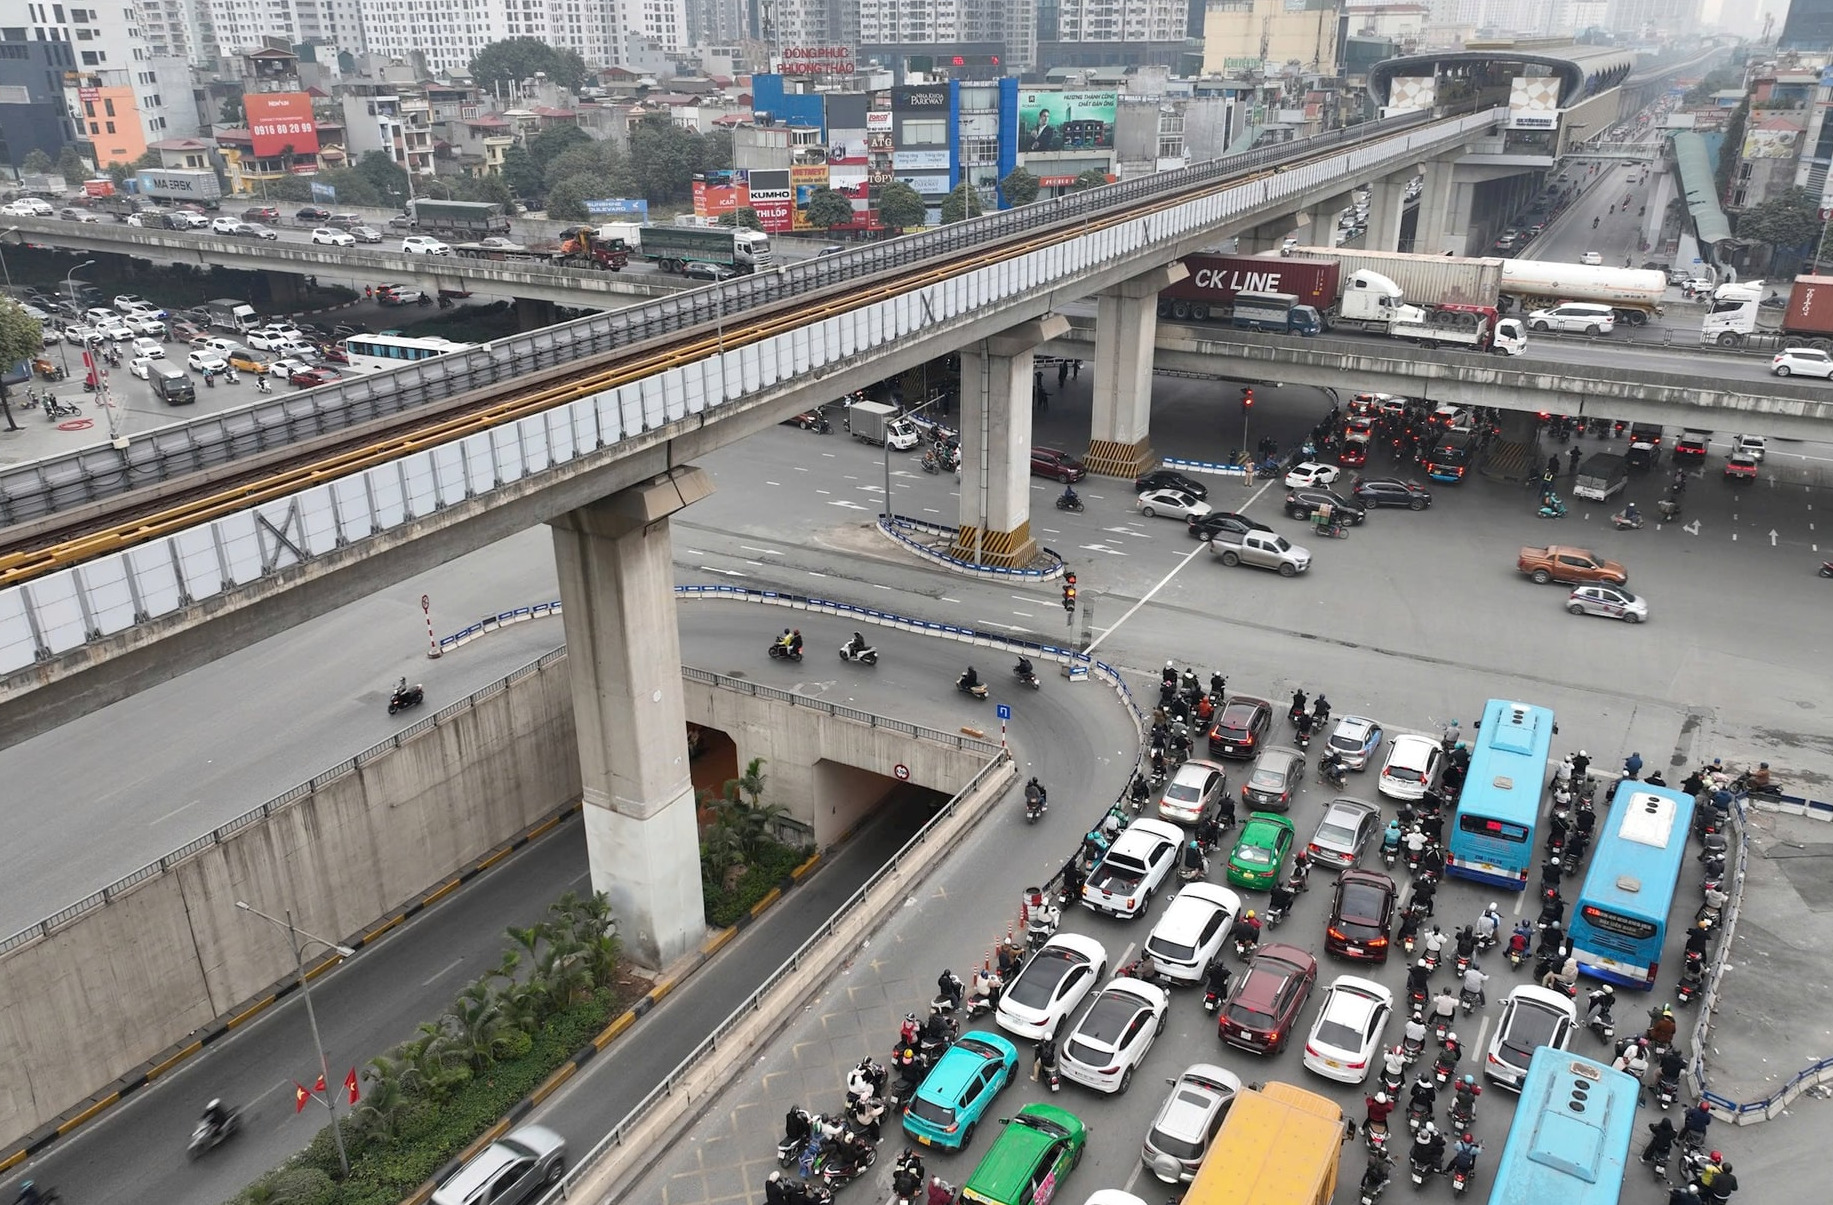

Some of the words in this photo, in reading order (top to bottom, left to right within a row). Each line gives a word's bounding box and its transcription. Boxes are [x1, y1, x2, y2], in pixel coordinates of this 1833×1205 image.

[911, 95, 943, 105] PARKWAY
[254, 124, 275, 135] 0916
[302, 122, 312, 133] 99
[871, 138, 892, 147] ATG
[154, 179, 193, 191] MAERSK
[751, 191, 790, 199] KUMHO
[771, 206, 788, 218] LỐP
[1195, 268, 1228, 289] CK
[1230, 271, 1281, 293] LINE
